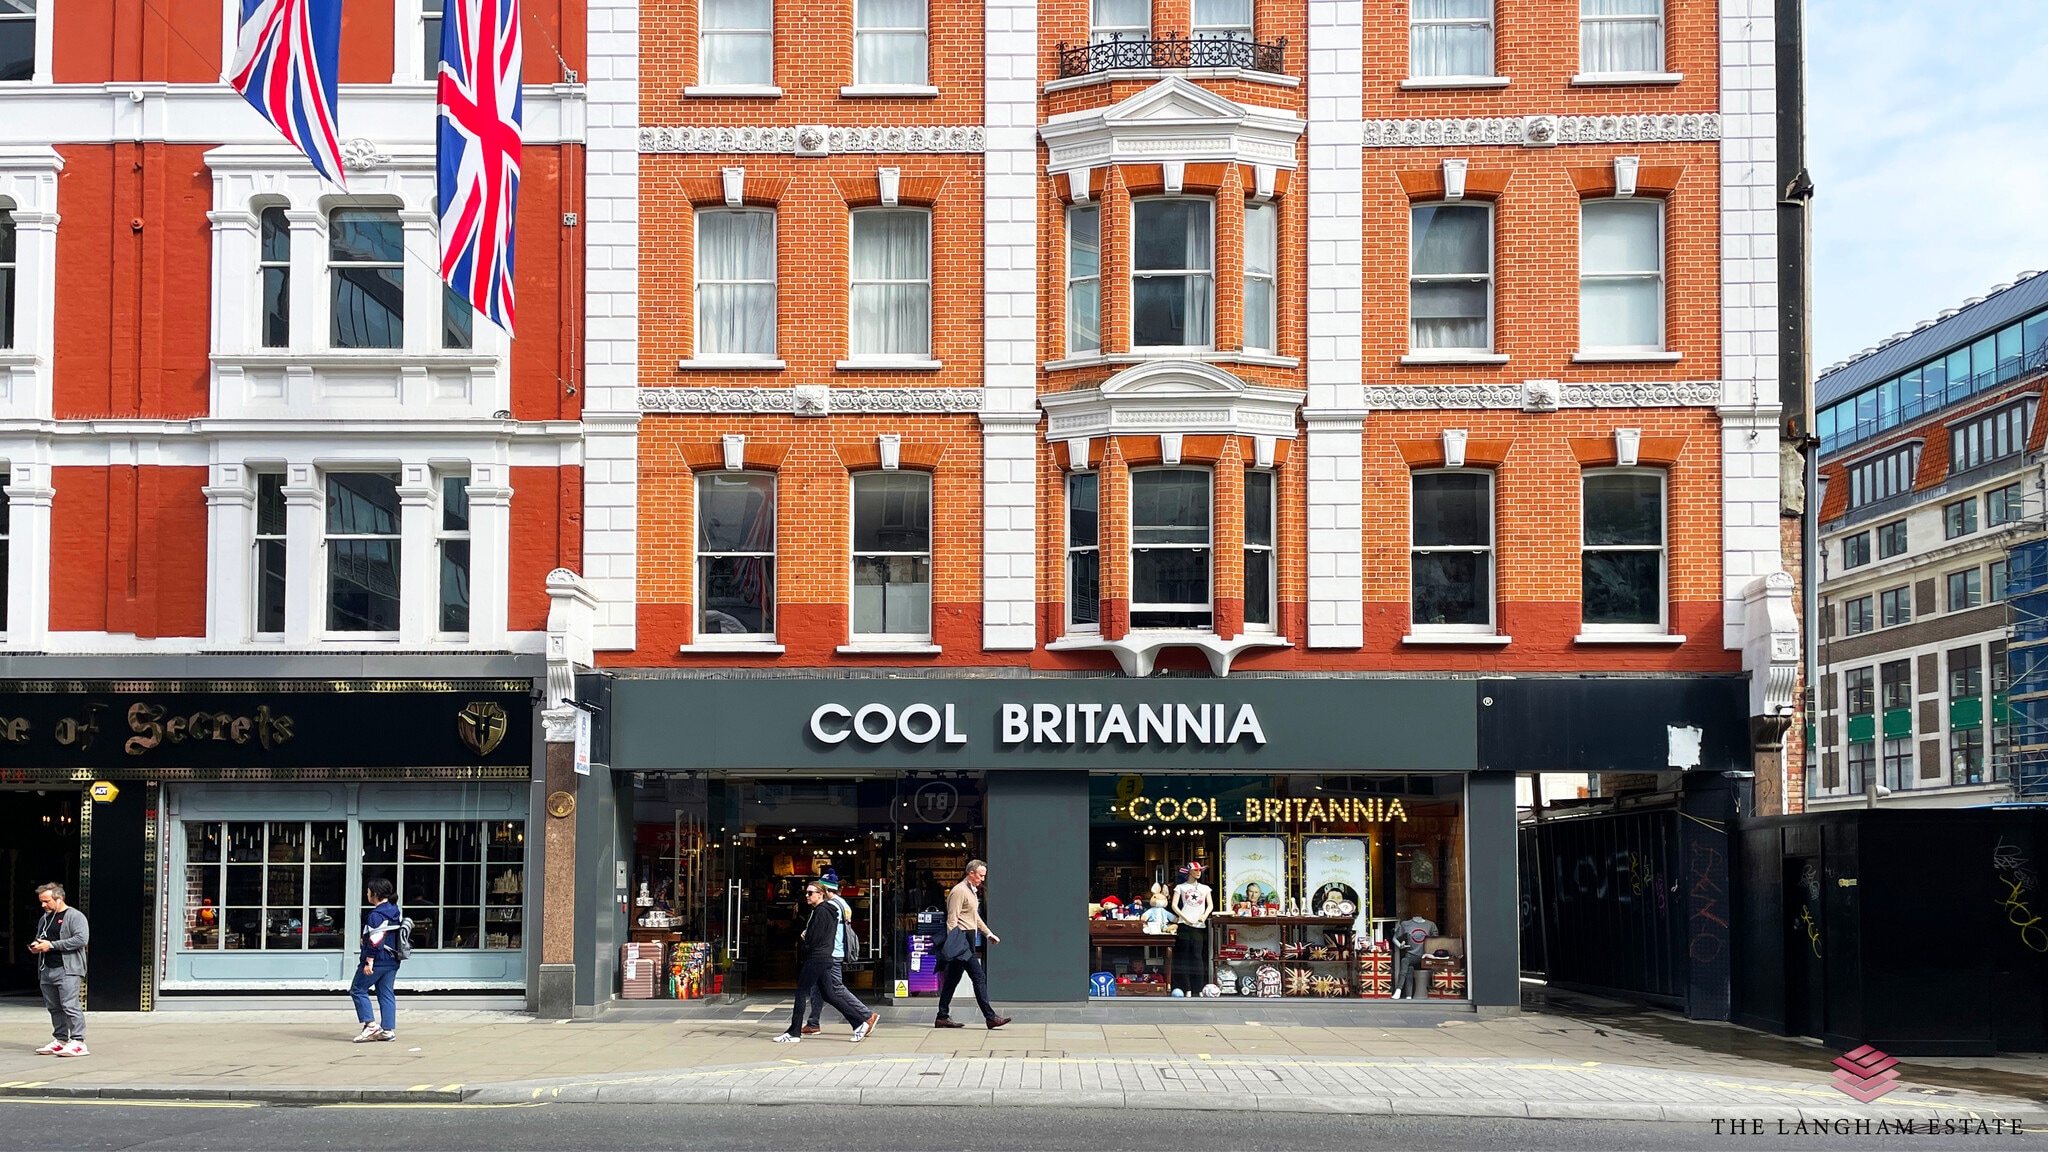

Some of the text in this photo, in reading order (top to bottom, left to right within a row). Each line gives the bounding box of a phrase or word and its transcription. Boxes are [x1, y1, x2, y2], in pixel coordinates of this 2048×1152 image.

[55, 702, 109, 751] of
[125, 702, 295, 755] Secrets
[810, 702, 1267, 743] COOL BRITANNIA
[1128, 796, 1408, 823] COOL BRITANNIA
